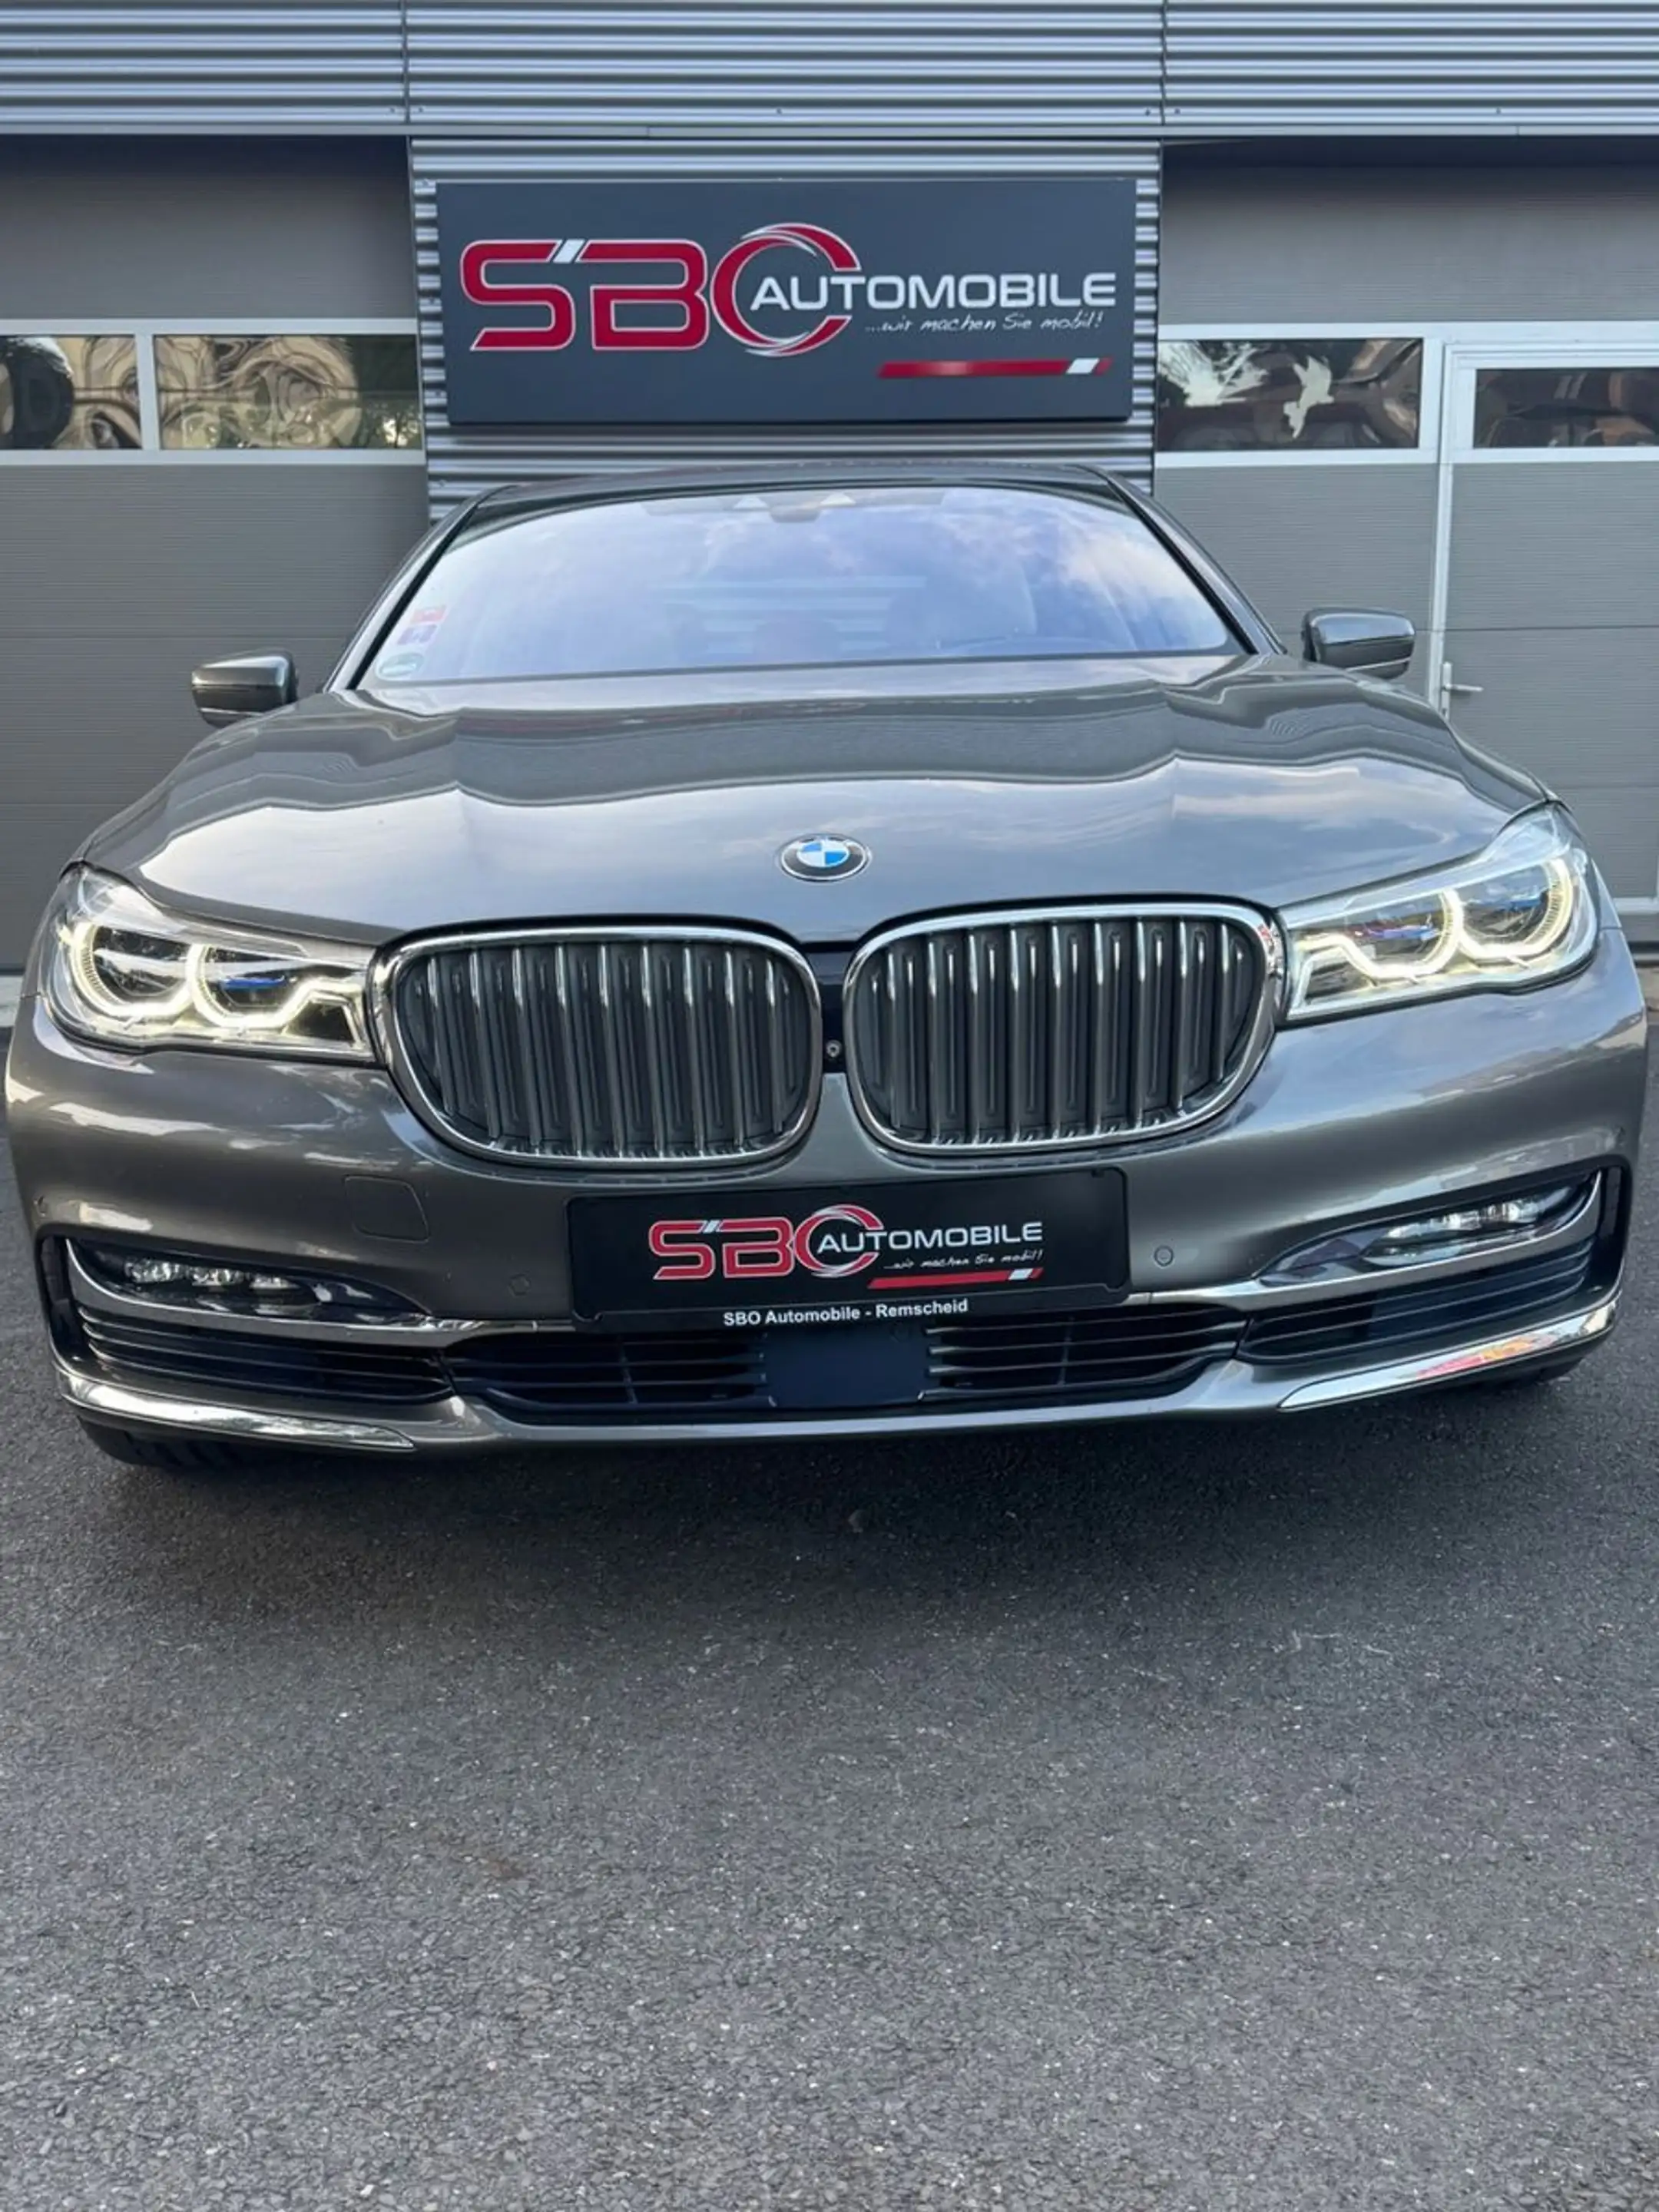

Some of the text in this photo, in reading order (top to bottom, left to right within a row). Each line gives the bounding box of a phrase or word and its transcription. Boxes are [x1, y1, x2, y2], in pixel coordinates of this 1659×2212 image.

[750, 272, 1116, 312] AUTOMOBILE
[920, 313, 997, 331] machen
[1002, 312, 1033, 330] Sie
[1040, 309, 1104, 329] mobil!
[817, 1222, 1043, 1253] AUTOMOBILE
[724, 1311, 760, 1326] SBO
[765, 1306, 861, 1325] Automobile
[876, 1298, 969, 1318] Remscheid
